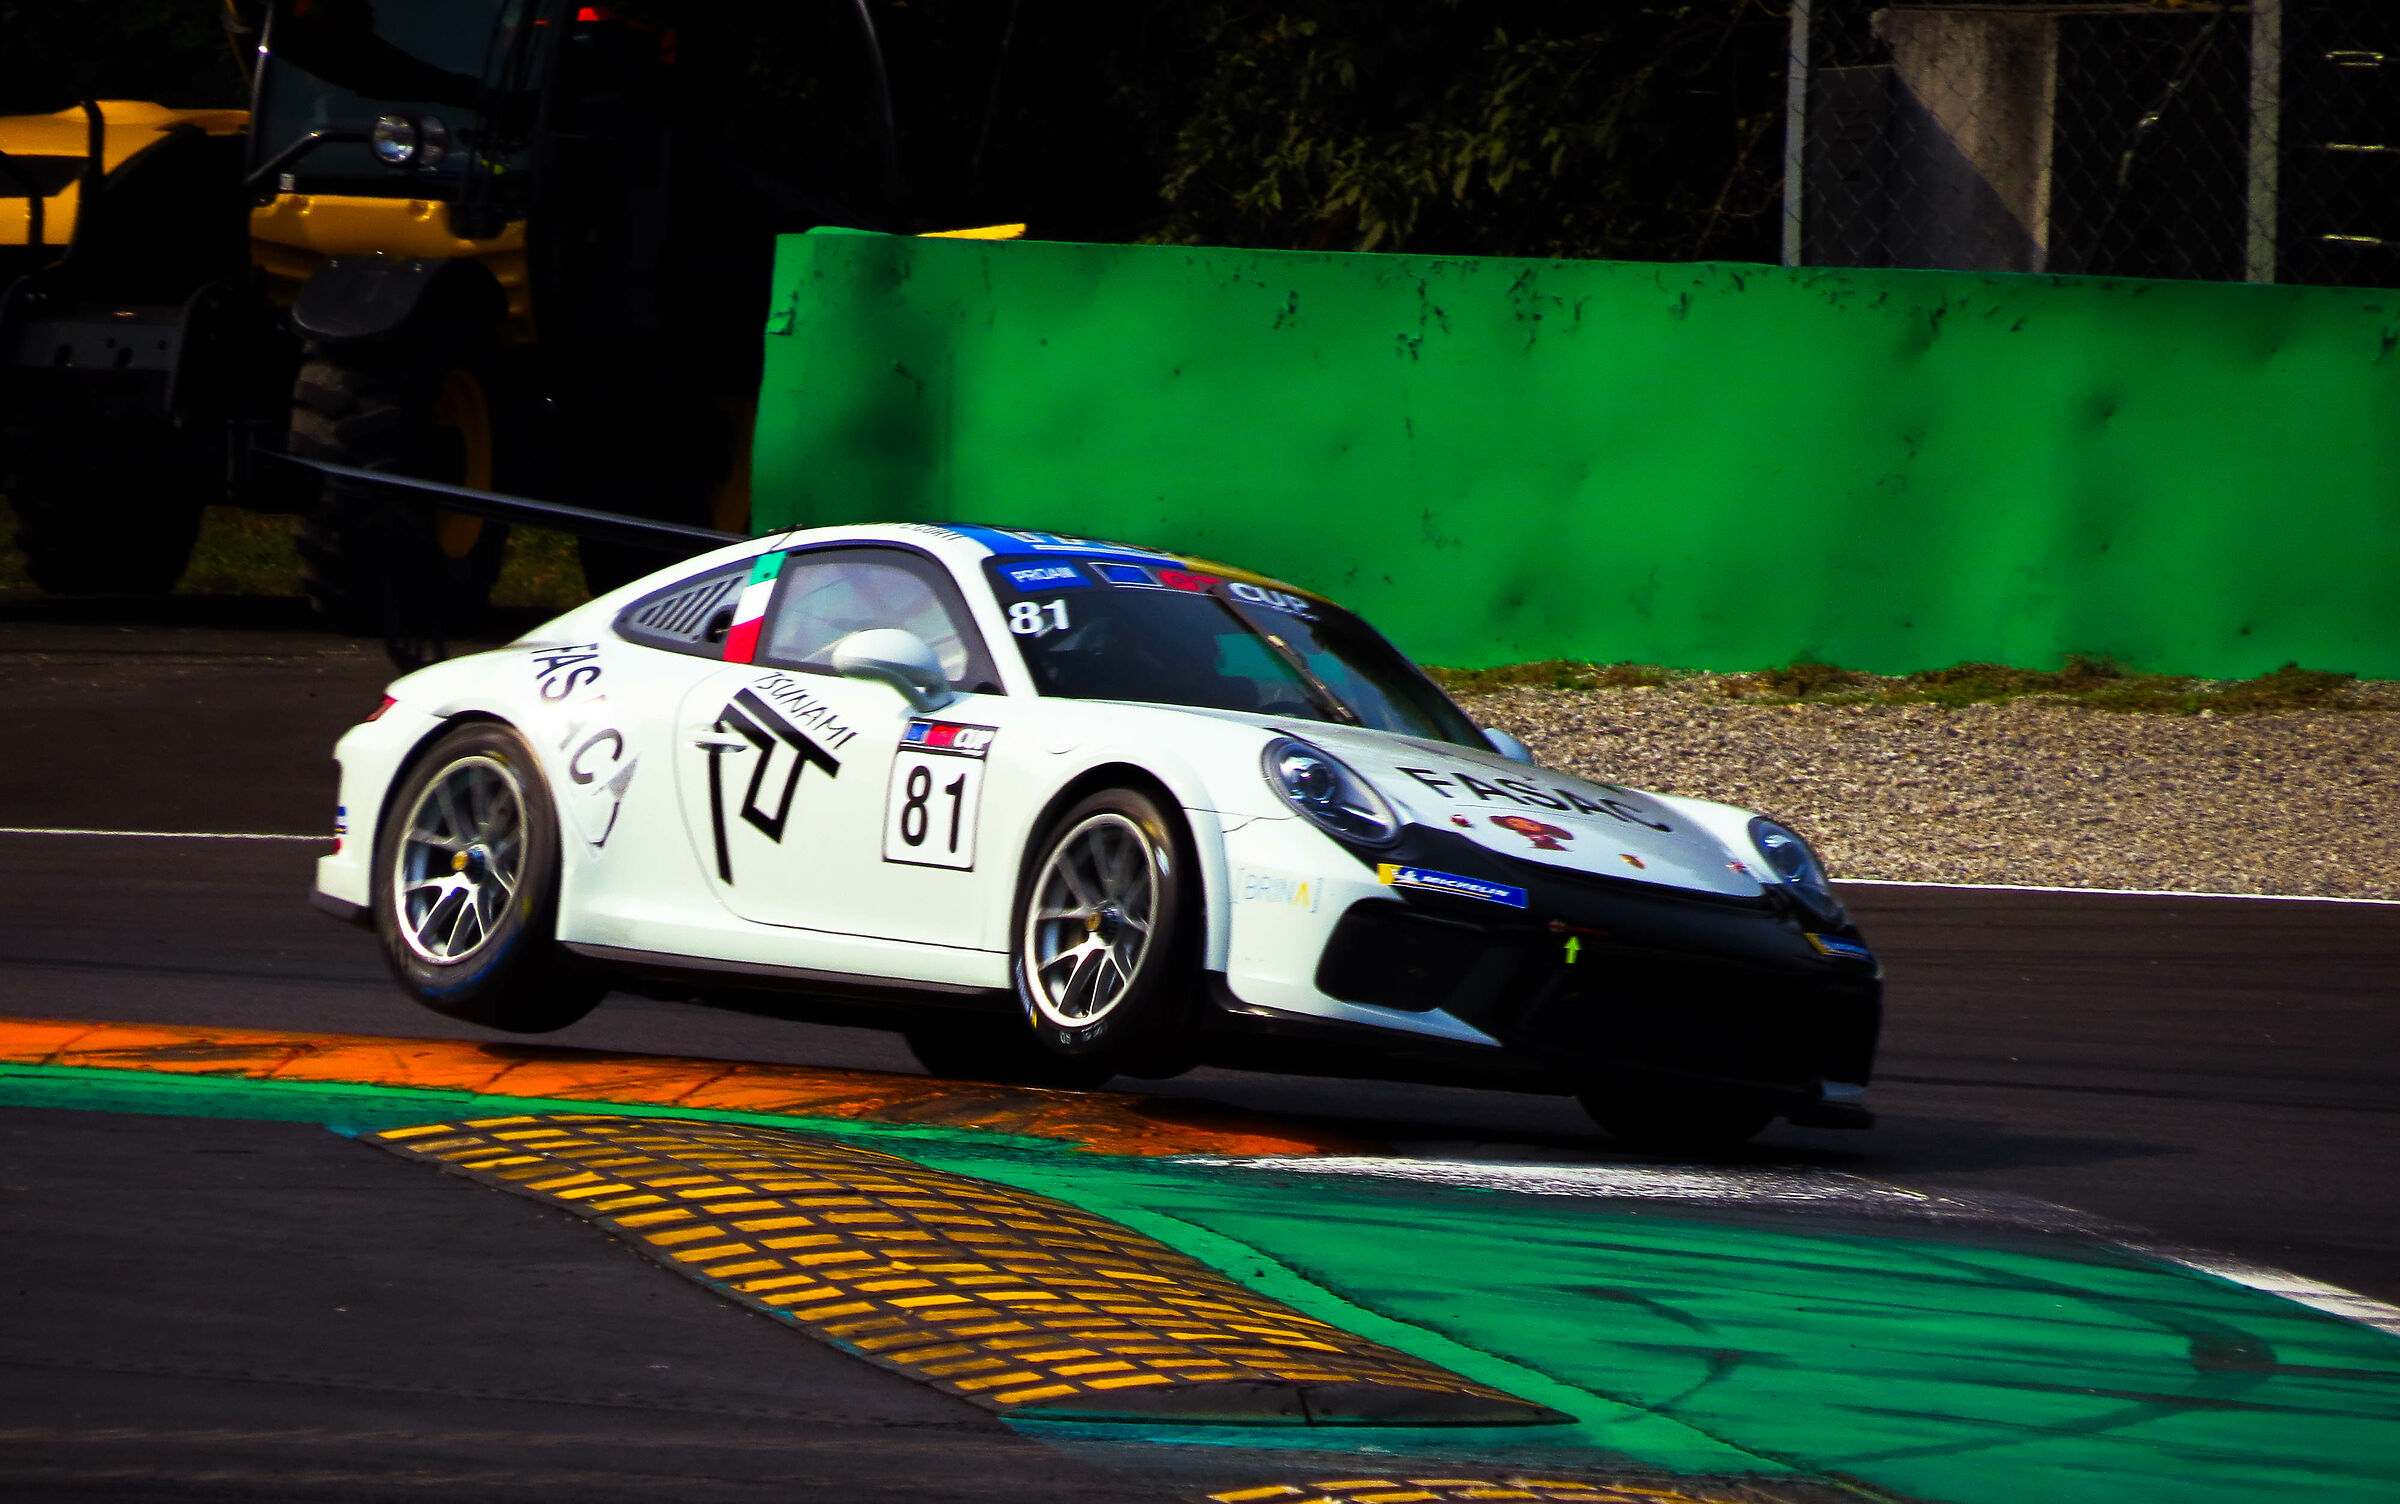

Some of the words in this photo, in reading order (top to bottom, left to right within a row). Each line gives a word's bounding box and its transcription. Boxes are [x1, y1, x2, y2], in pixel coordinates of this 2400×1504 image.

[1008, 599, 1070, 635] 81
[1228, 582, 1311, 612] CUP
[530, 642, 624, 785] FASC
[754, 671, 859, 750] TSUNAMI
[901, 765, 966, 854] 81
[1395, 766, 1673, 833] FASAC
[1422, 875, 1511, 898] MICHELIN
